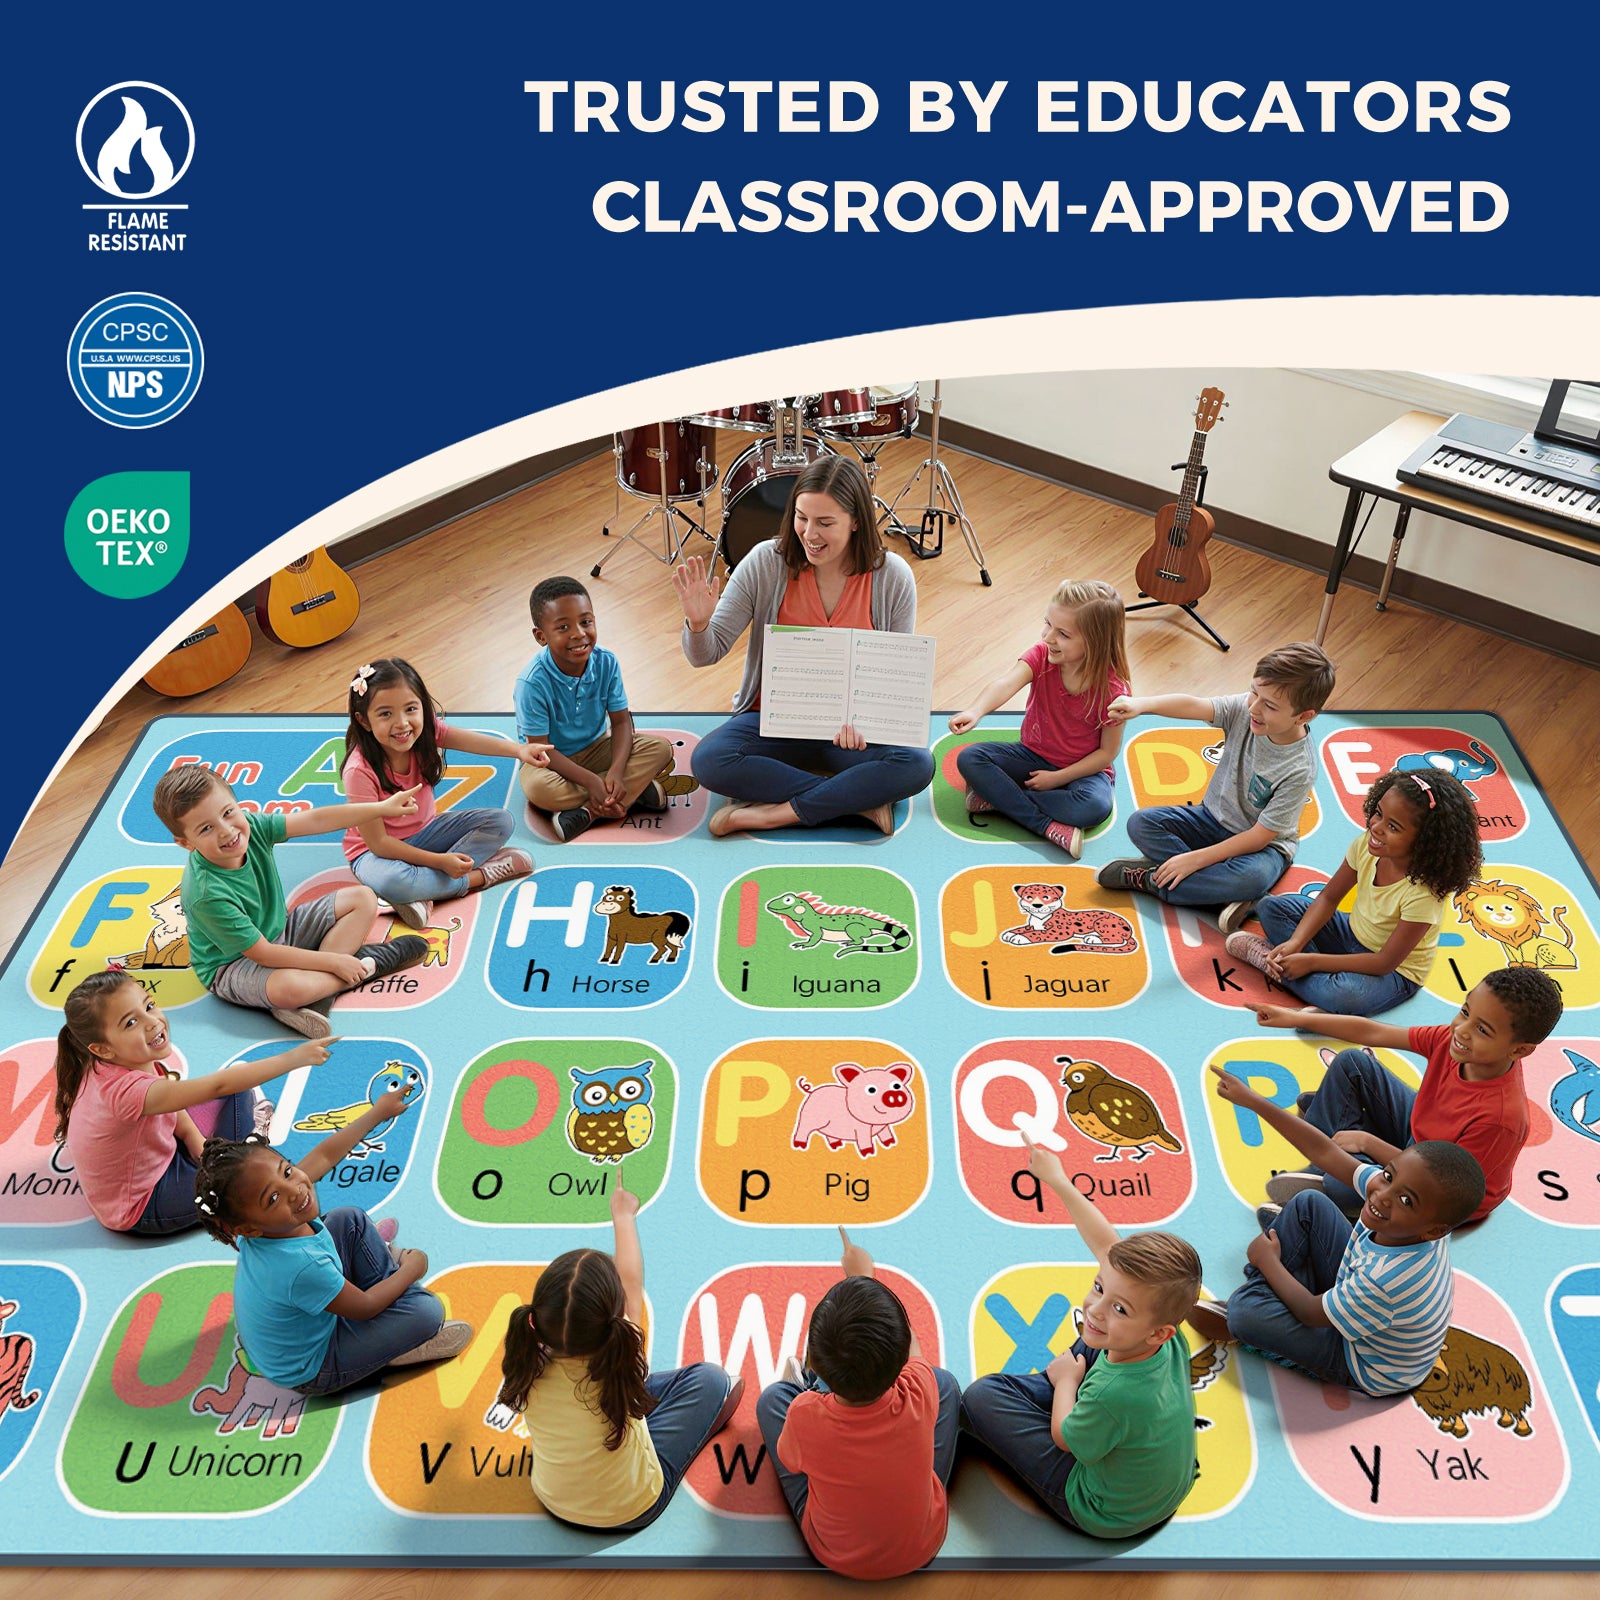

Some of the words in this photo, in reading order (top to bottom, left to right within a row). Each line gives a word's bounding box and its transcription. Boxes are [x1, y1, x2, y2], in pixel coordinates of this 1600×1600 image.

[1134, 743, 1208, 796] D
[1328, 742, 1381, 796] E
[620, 814, 663, 829] Ant
[70, 882, 150, 949] F
[505, 881, 595, 948] H
[949, 880, 998, 948] J
[48, 958, 77, 993] f
[523, 959, 551, 993] h
[572, 975, 650, 994] Horse
[741, 960, 750, 992] i
[793, 975, 881, 998] Iguana
[1024, 975, 1111, 997] Jaguar
[461, 1059, 561, 1147] O
[715, 1060, 792, 1147] P
[959, 1059, 1068, 1152] Q
[548, 1172, 608, 1196] Owl
[825, 1173, 870, 1202] Pig
[1011, 1169, 1044, 1212] q
[1071, 1173, 1151, 1201] Quail
[111, 1291, 234, 1409] U
[698, 1292, 806, 1394] W
[984, 1293, 1072, 1375] X
[168, 1444, 303, 1477] Unicorn
[1416, 1447, 1490, 1481] Yak
